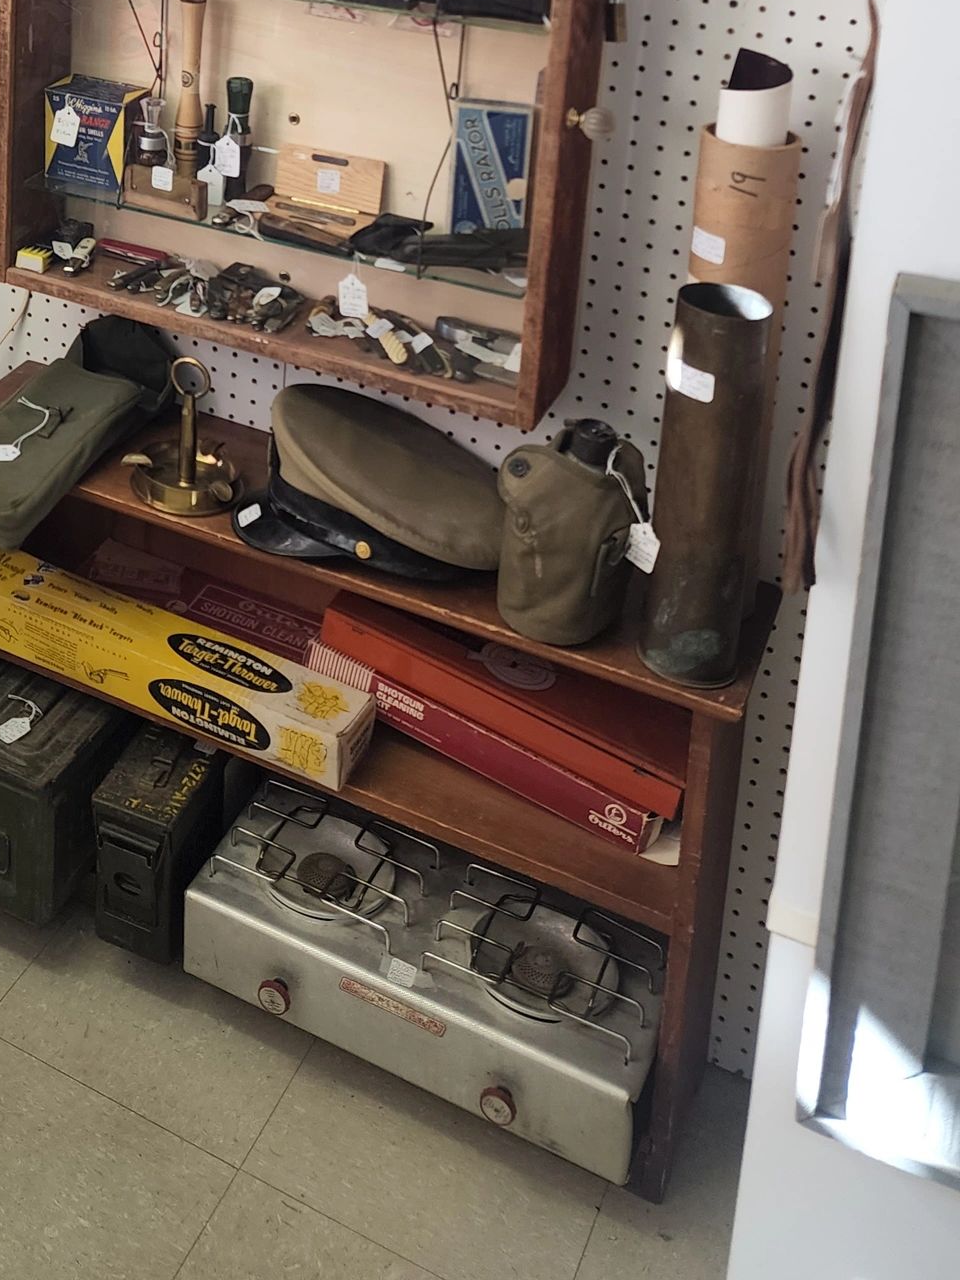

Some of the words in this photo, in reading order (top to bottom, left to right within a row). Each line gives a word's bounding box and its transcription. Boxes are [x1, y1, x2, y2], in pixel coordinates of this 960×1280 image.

[464, 118, 496, 182] RAZOR
[486, 187, 511, 230] OLLS
[35, 597, 69, 616] Remington
[109, 627, 134, 644] Targets
[200, 601, 259, 631] SHOTGUN
[178, 638, 279, 692] Target-Thrower
[196, 638, 273, 676] REMINGTON
[158, 682, 259, 743] Target-Thrower
[376, 691, 424, 721] CLEANING
[377, 682, 425, 712] SHOTGUN
[171, 705, 247, 745] REMINGTON
